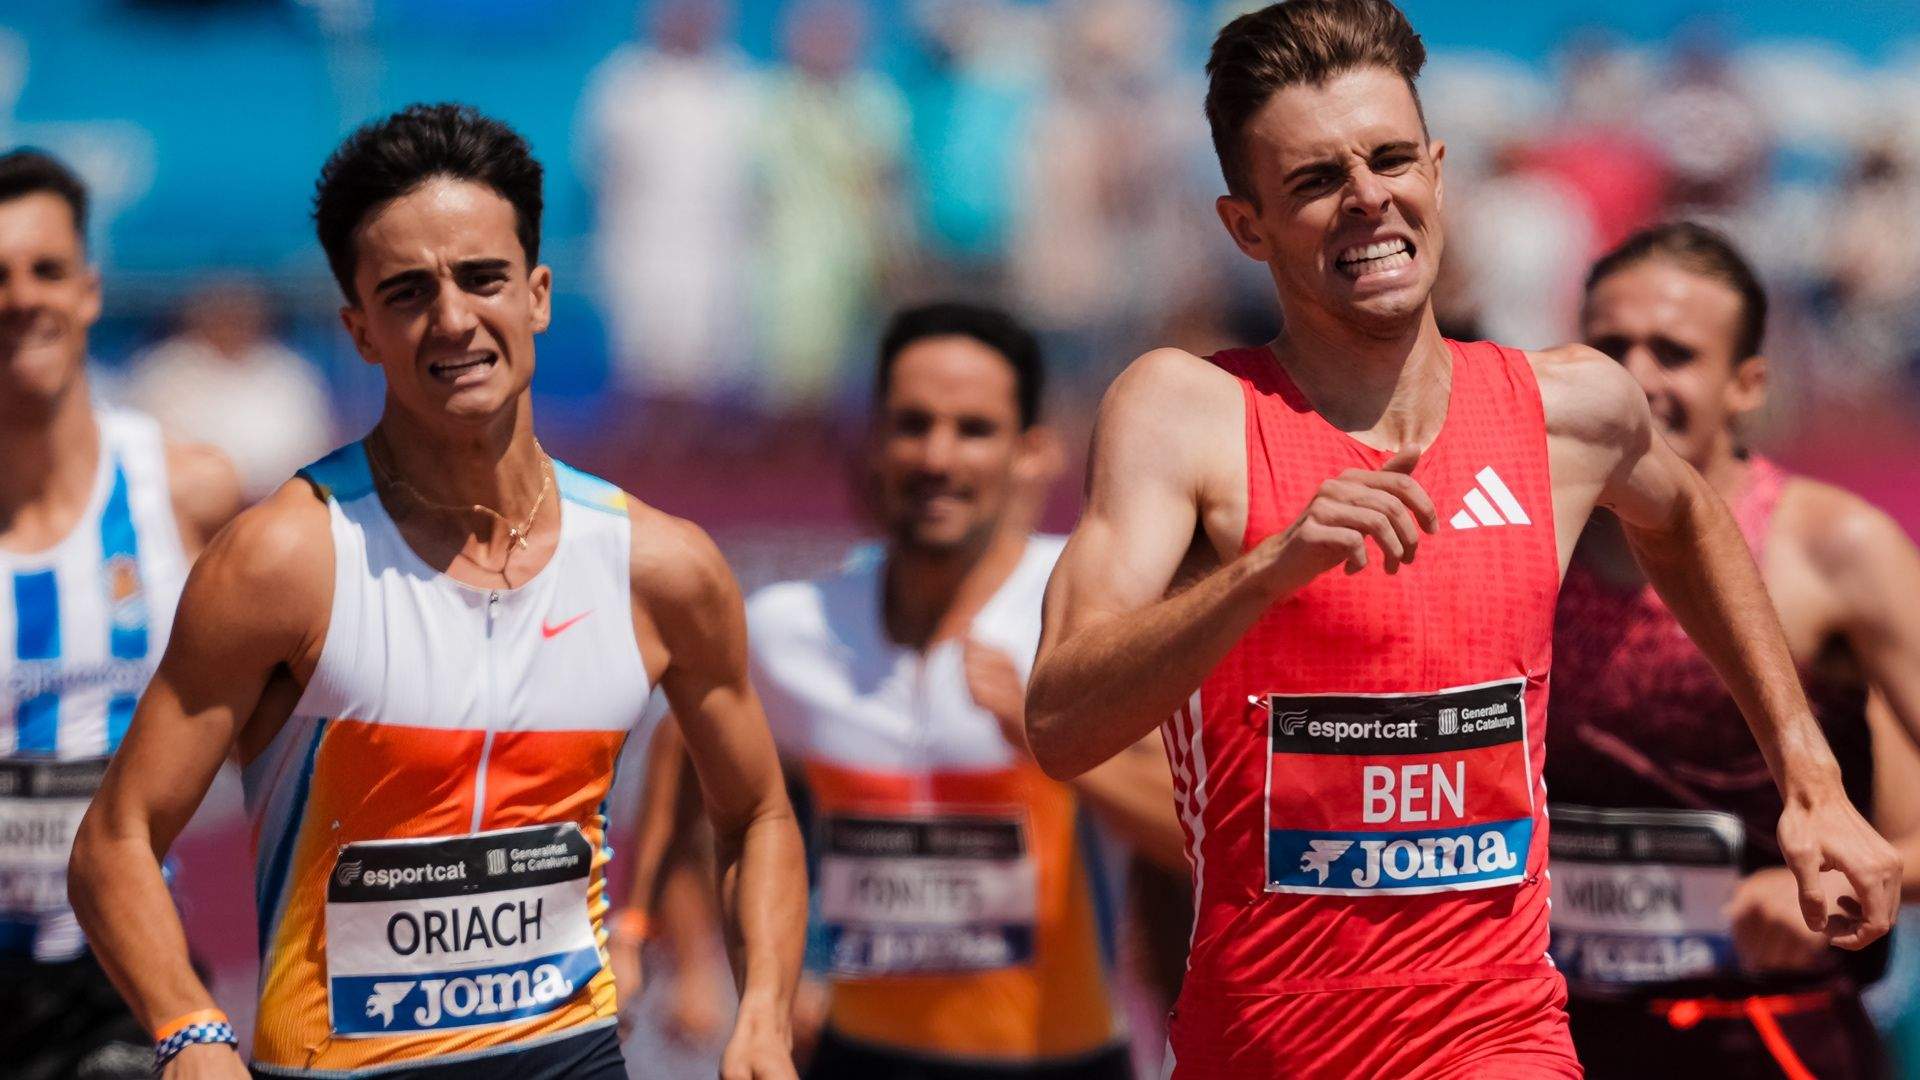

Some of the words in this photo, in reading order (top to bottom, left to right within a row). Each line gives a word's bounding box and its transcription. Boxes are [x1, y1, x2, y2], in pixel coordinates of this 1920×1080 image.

[1461, 703, 1507, 720] Generalitat
[1461, 722, 1475, 733] de
[1475, 716, 1515, 731] Catalunya
[1307, 719, 1418, 742] esportcat
[1362, 760, 1466, 823] BEN
[362, 861, 467, 890] esportcat
[387, 898, 544, 956] ORIACH
